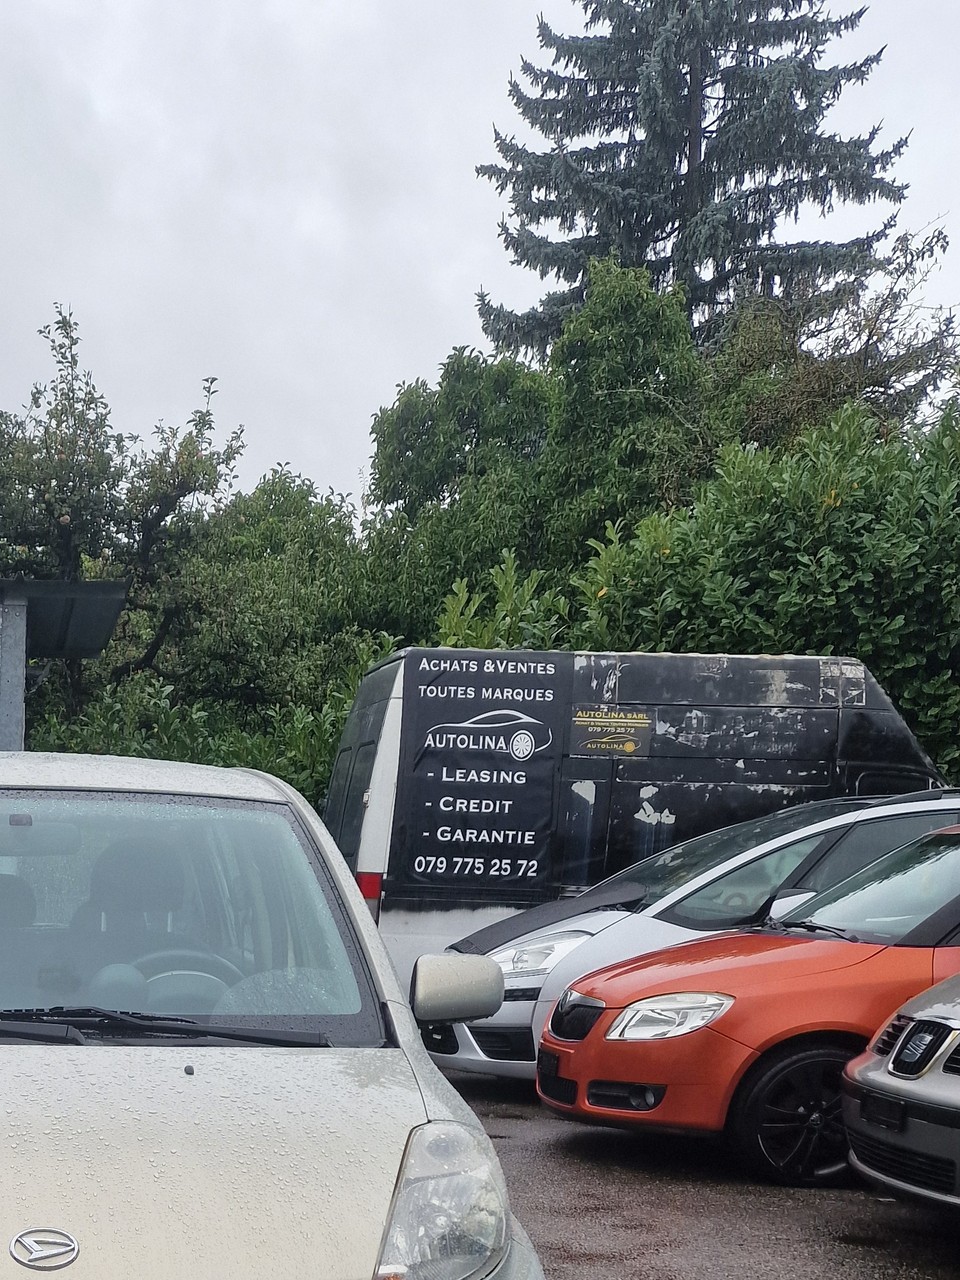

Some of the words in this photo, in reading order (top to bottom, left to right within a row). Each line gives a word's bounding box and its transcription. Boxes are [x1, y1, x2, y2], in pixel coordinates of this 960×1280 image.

[418, 657, 478, 672] ACHATS
[418, 685, 475, 699] TOUTES
[481, 687, 554, 702] MARQUES
[576, 710, 625, 719] AUTOLINA
[424, 733, 507, 750] AUTOLINA
[441, 767, 527, 784] LEASING
[439, 796, 513, 814] CREDIT
[436, 826, 536, 845] GARANTIE
[414, 856, 447, 873] 079
[452, 857, 484, 875] 775
[489, 858, 511, 876] 25
[517, 859, 538, 877] 72
